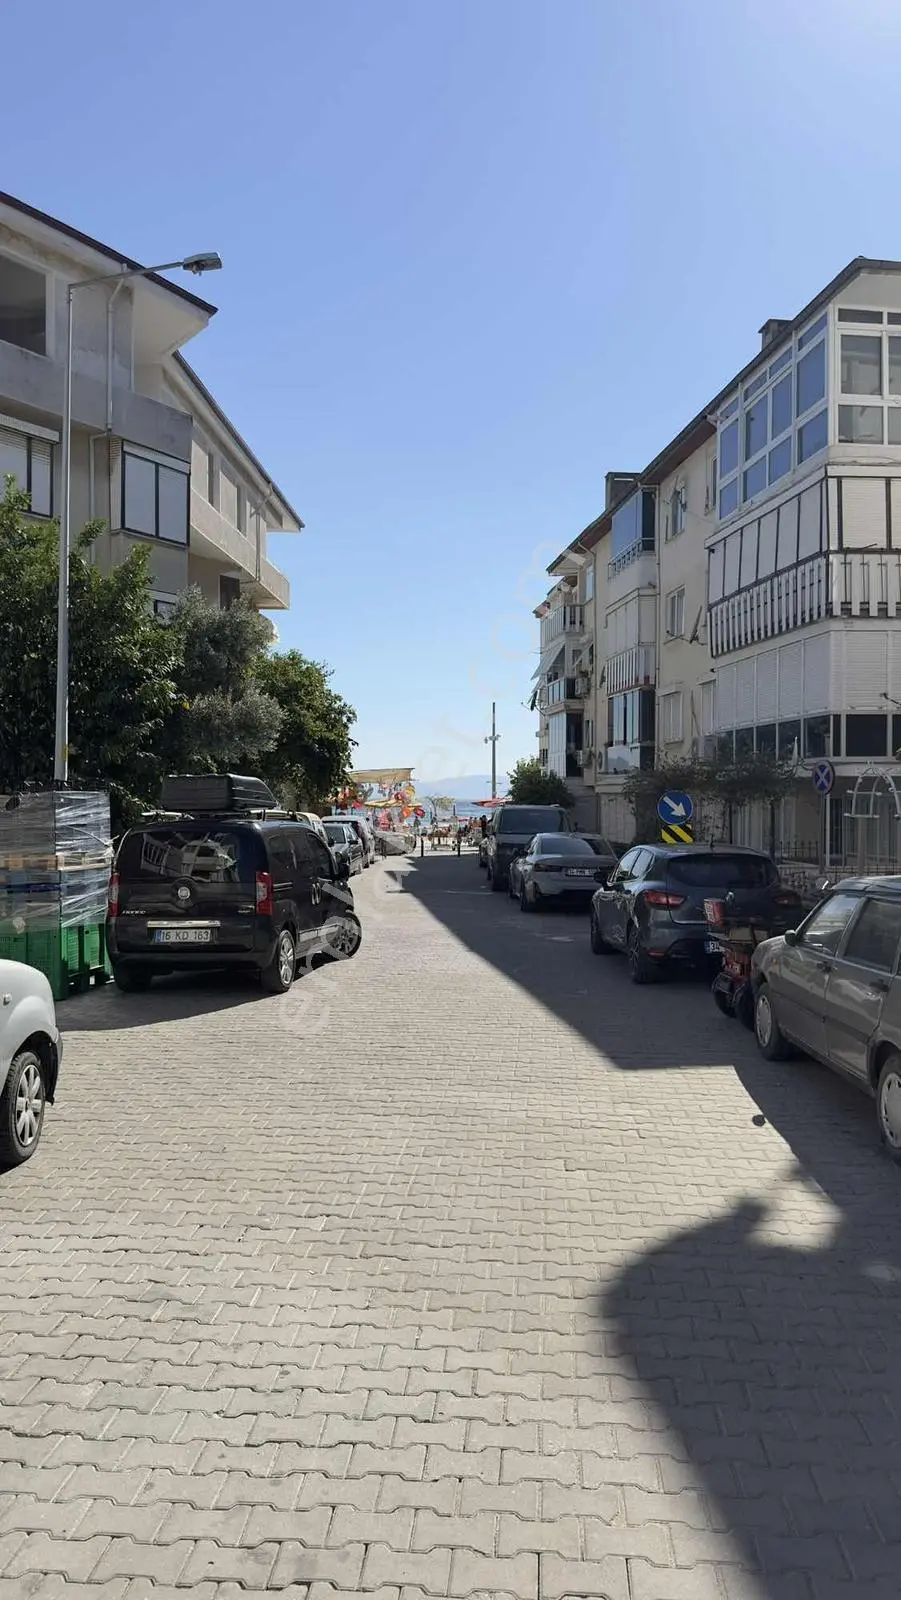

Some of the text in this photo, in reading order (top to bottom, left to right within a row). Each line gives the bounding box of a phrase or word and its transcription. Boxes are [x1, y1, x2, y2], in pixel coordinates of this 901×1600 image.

[161, 931, 209, 942] 16 KD 163
